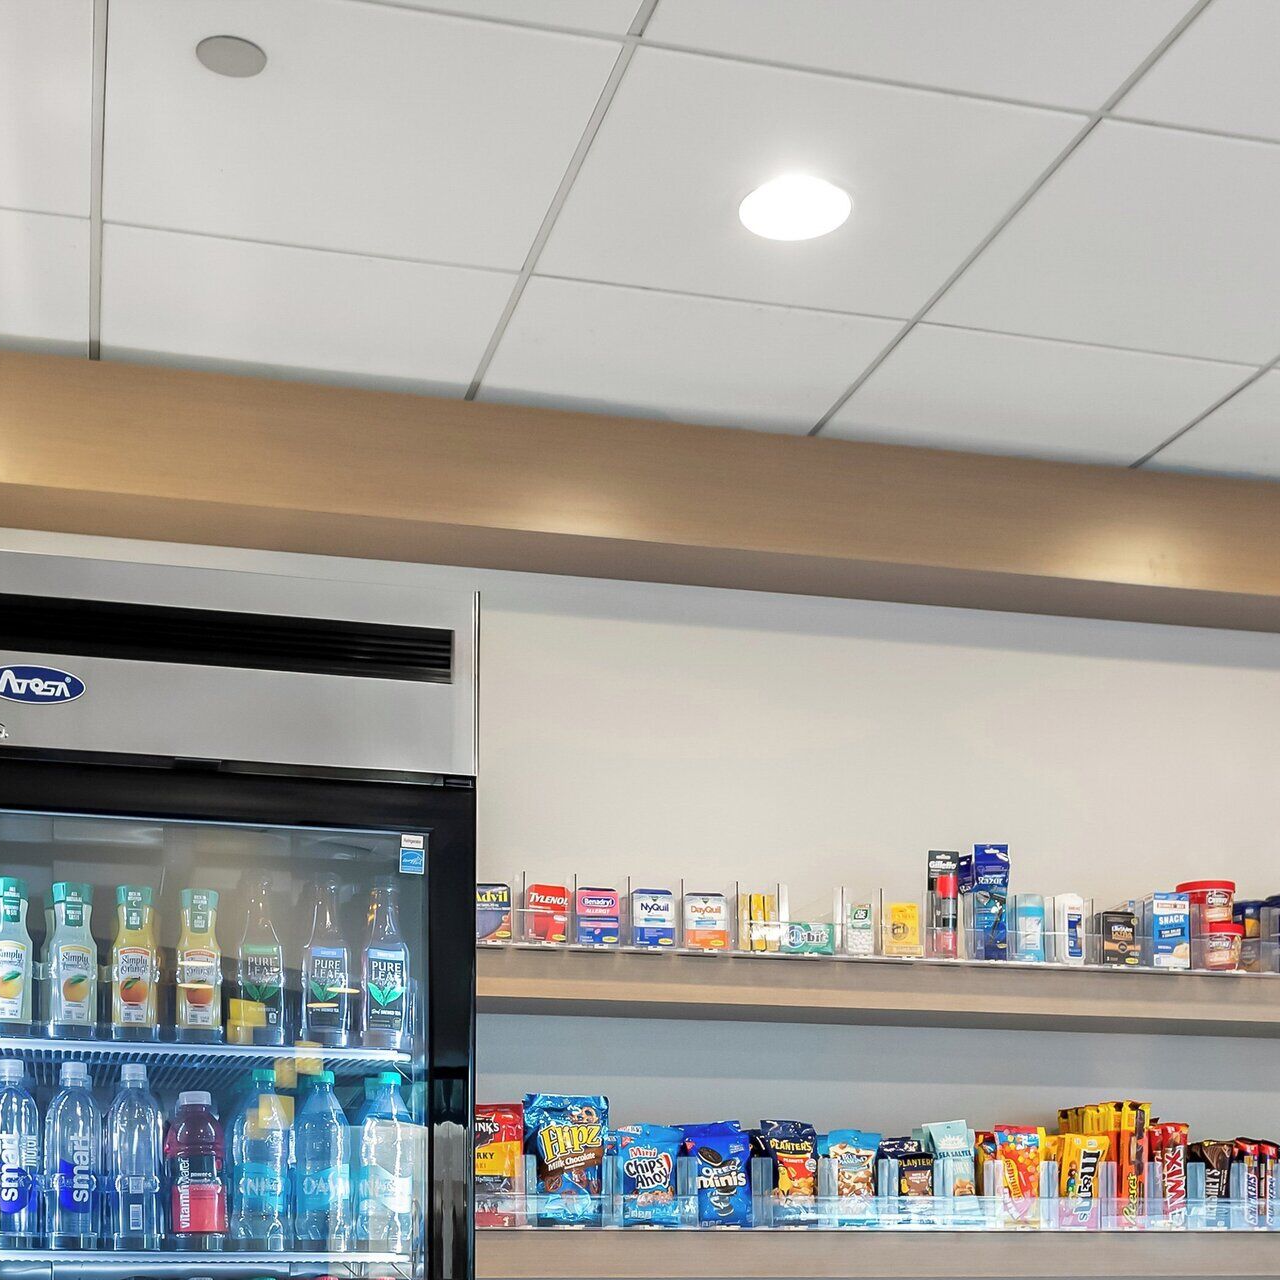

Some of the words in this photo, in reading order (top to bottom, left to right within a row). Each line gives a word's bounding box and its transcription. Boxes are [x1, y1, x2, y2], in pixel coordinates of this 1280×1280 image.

[476, 890, 509, 903] Advil
[529, 891, 569, 906] TYLENOL
[584, 896, 613, 907] Benadryl
[640, 902, 670, 914] NyQuil
[690, 905, 722, 916] DayQuil
[1159, 914, 1185, 925] SNACK
[314, 960, 341, 970] PURE
[371, 961, 402, 972] PURE
[540, 1124, 603, 1162] Flipz
[770, 1139, 813, 1151] PLANTERS
[629, 1147, 657, 1158] Mini
[0, 1130, 19, 1203] smart
[70, 1131, 90, 1203] smart
[548, 1159, 566, 1171] Milk
[565, 1152, 596, 1165] Chocolate
[626, 1157, 664, 1178] Chips
[701, 1163, 740, 1177] OREO
[697, 1172, 748, 1190] minis
[1246, 1173, 1259, 1225] SNICKERS
